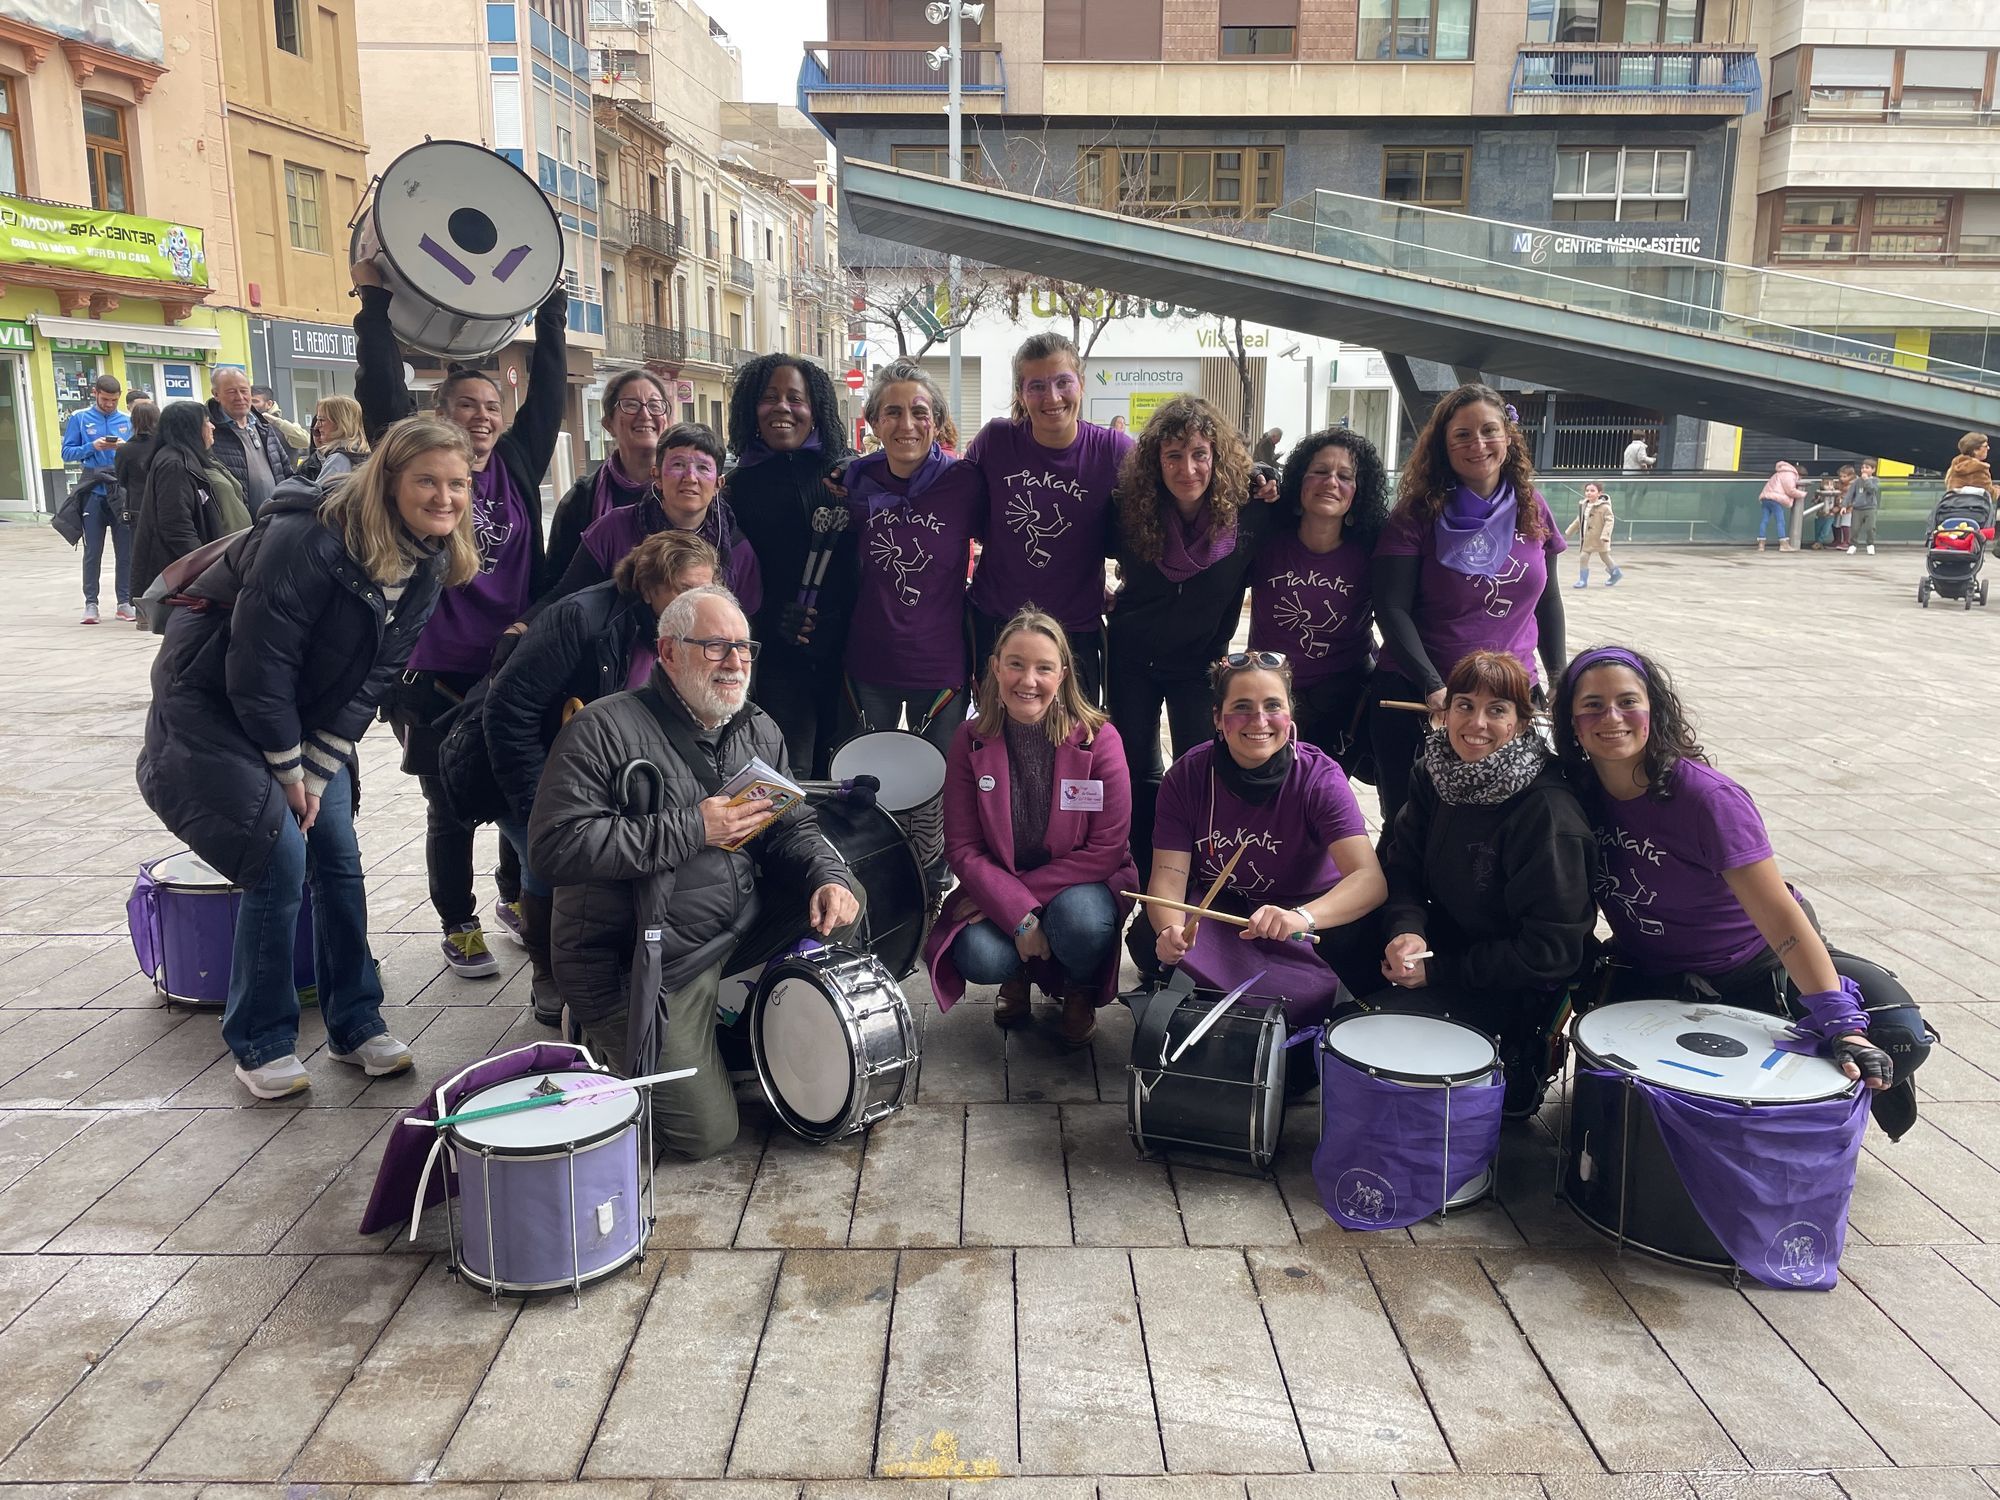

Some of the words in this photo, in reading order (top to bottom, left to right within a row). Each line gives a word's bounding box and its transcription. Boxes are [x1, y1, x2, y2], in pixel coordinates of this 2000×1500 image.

[1554, 237, 1603, 254] CENTRE
[292, 329, 305, 352] EL
[306, 331, 339, 355] REBOST
[1197, 328, 1269, 348] Vila-eal
[1115, 368, 1184, 382] ruralnostra
[165, 379, 190, 389] DIGI
